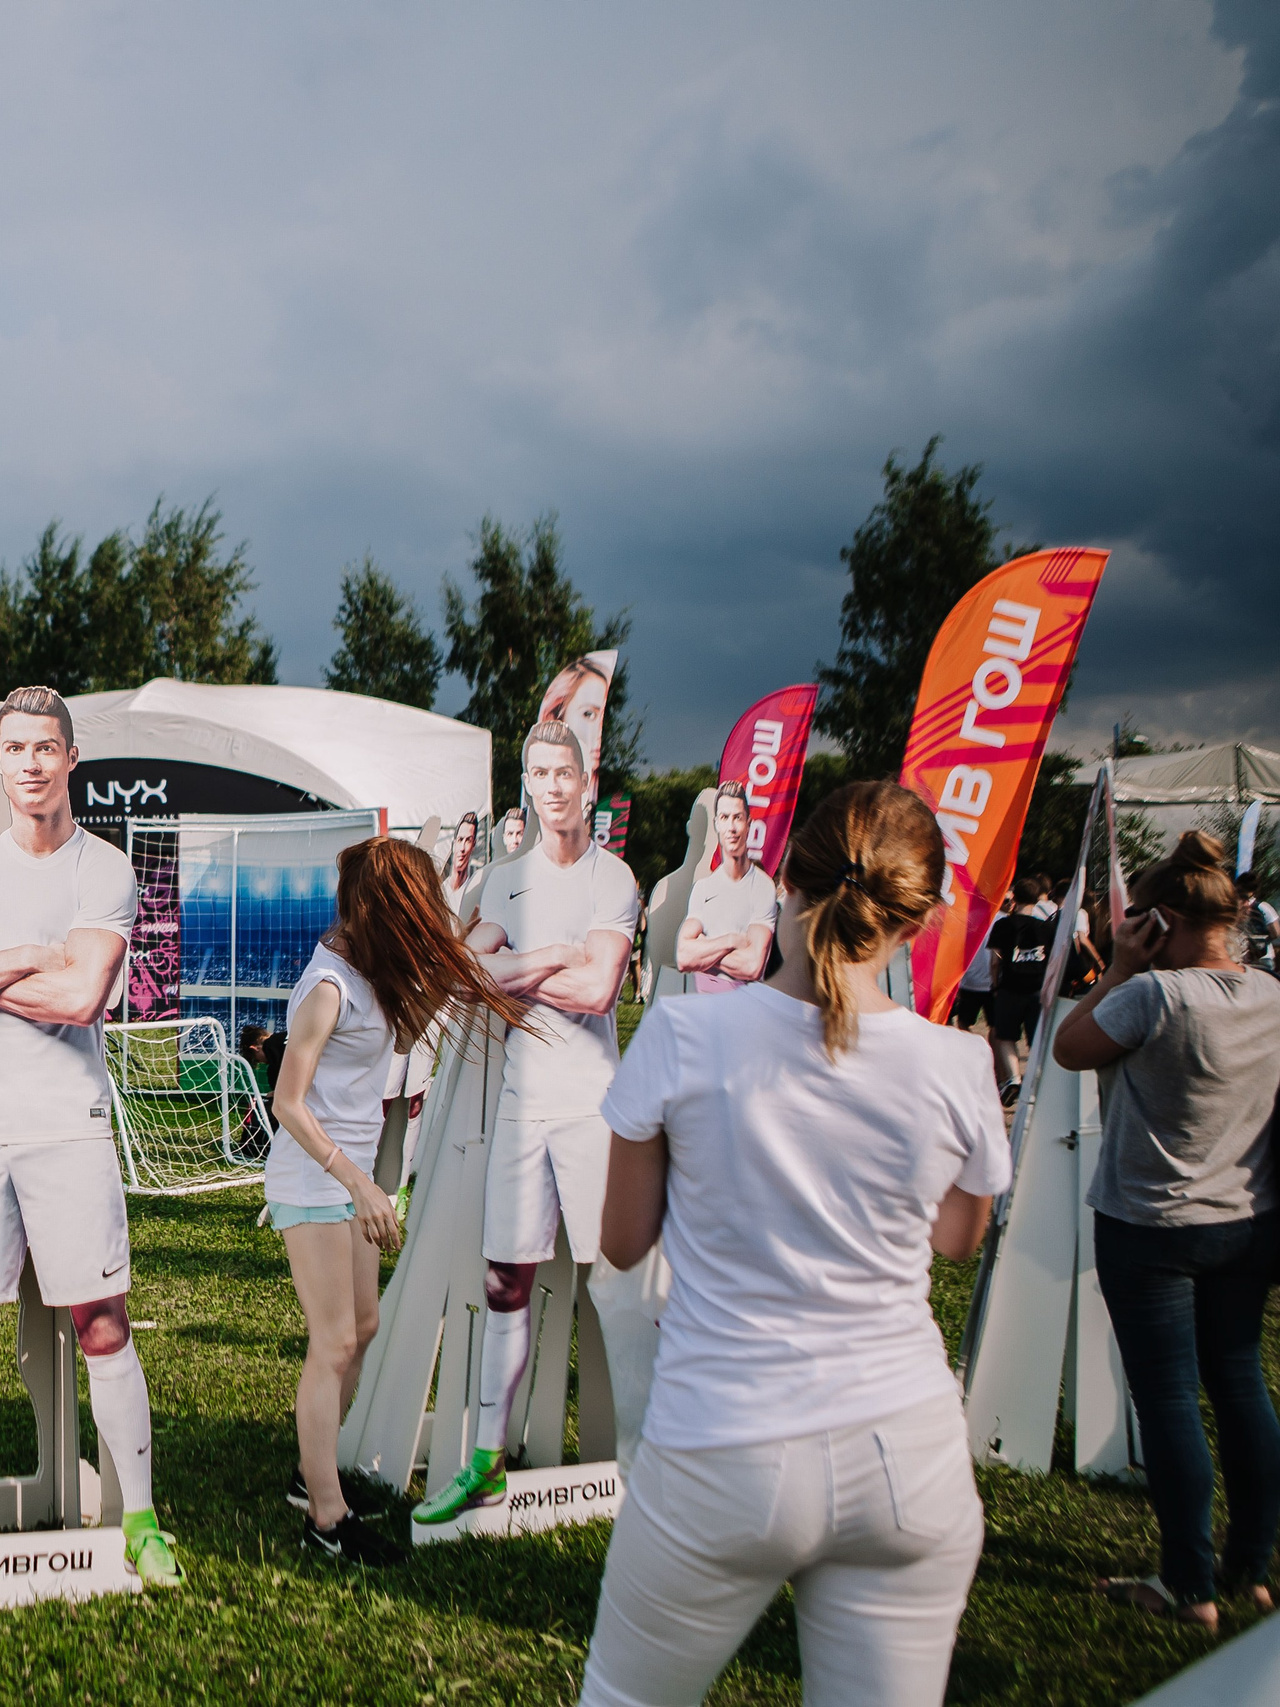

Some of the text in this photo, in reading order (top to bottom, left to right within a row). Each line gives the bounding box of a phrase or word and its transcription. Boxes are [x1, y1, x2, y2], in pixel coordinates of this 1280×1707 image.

[959, 598, 1041, 749] ГОШ
[746, 719, 783, 808] ГОШ
[86, 778, 168, 807] NYX
[594, 811, 613, 847] ОШ
[508, 1478, 615, 1511] #РИВГОШ
